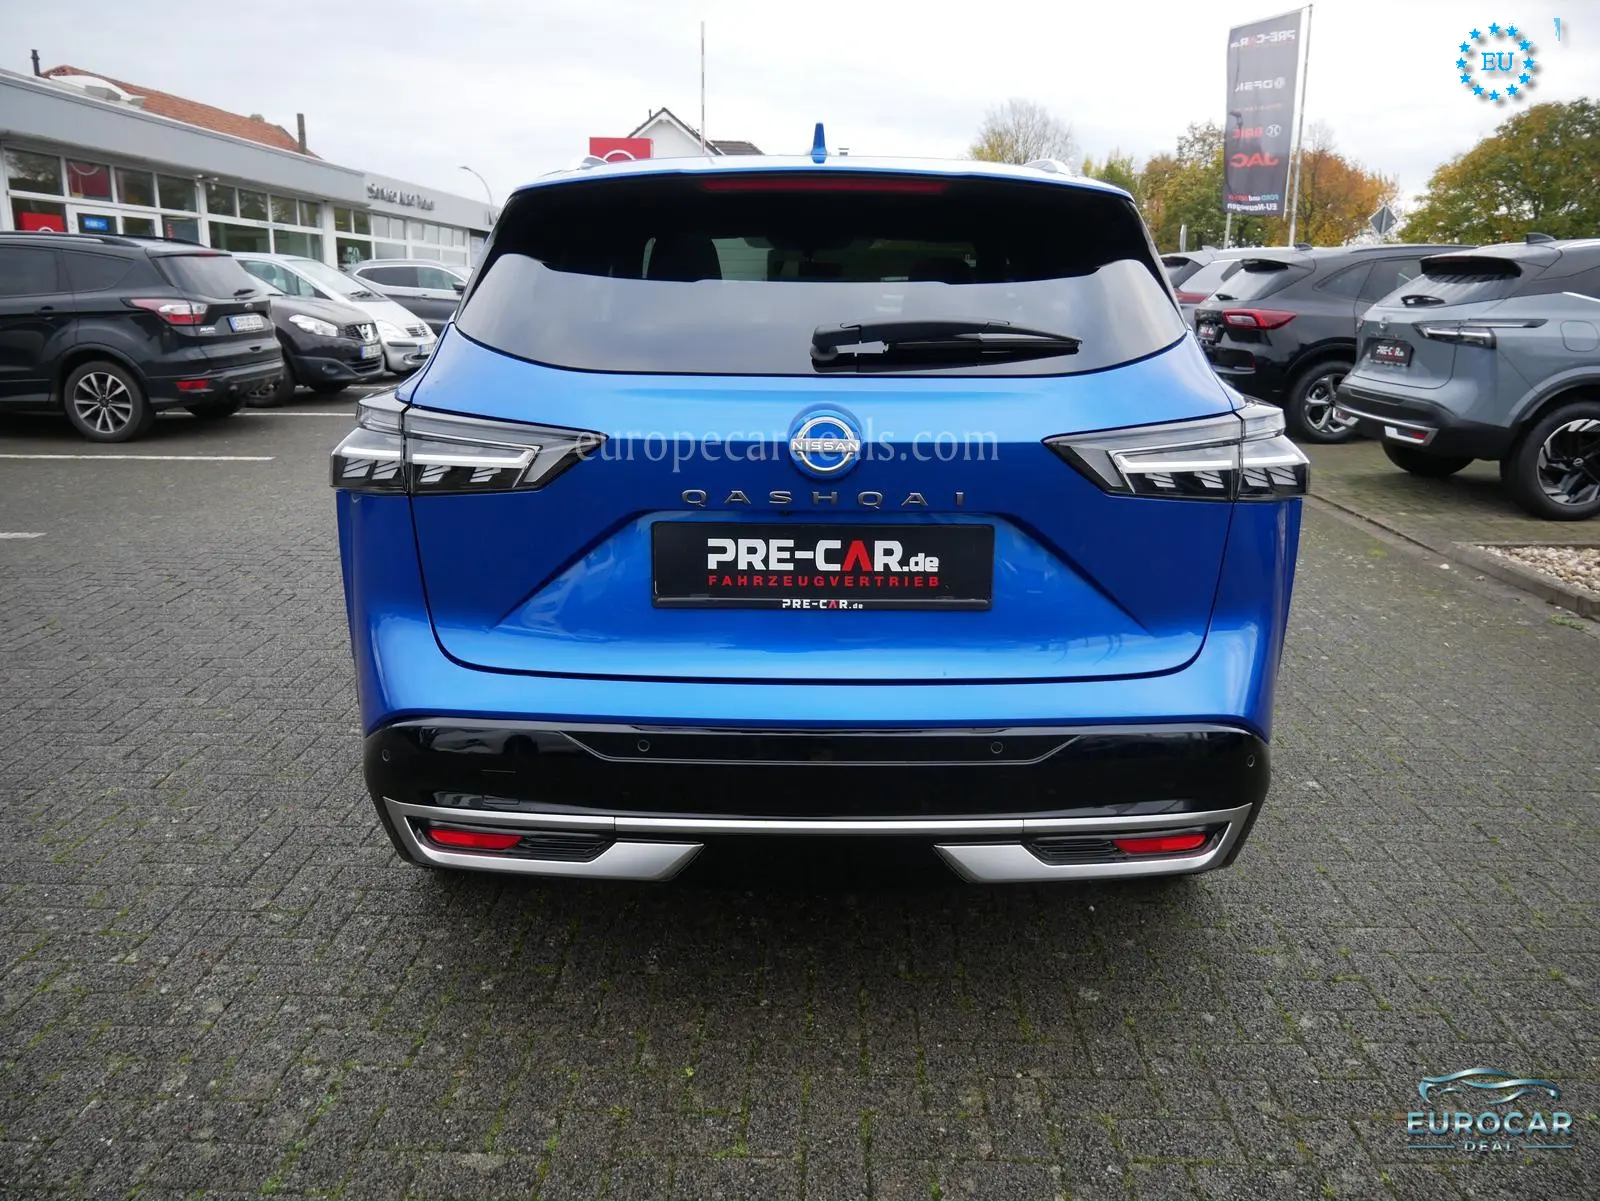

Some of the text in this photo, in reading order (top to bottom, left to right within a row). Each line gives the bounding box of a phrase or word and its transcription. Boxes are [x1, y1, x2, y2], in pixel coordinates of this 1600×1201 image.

[791, 440, 859, 452] NISSAN
[681, 489, 964, 509] QASHQAI
[707, 538, 940, 572] PRE-CAR.de
[708, 575, 940, 588] FAHRZEUGVERTRIEB
[782, 598, 864, 609] PRE-CAR.de
